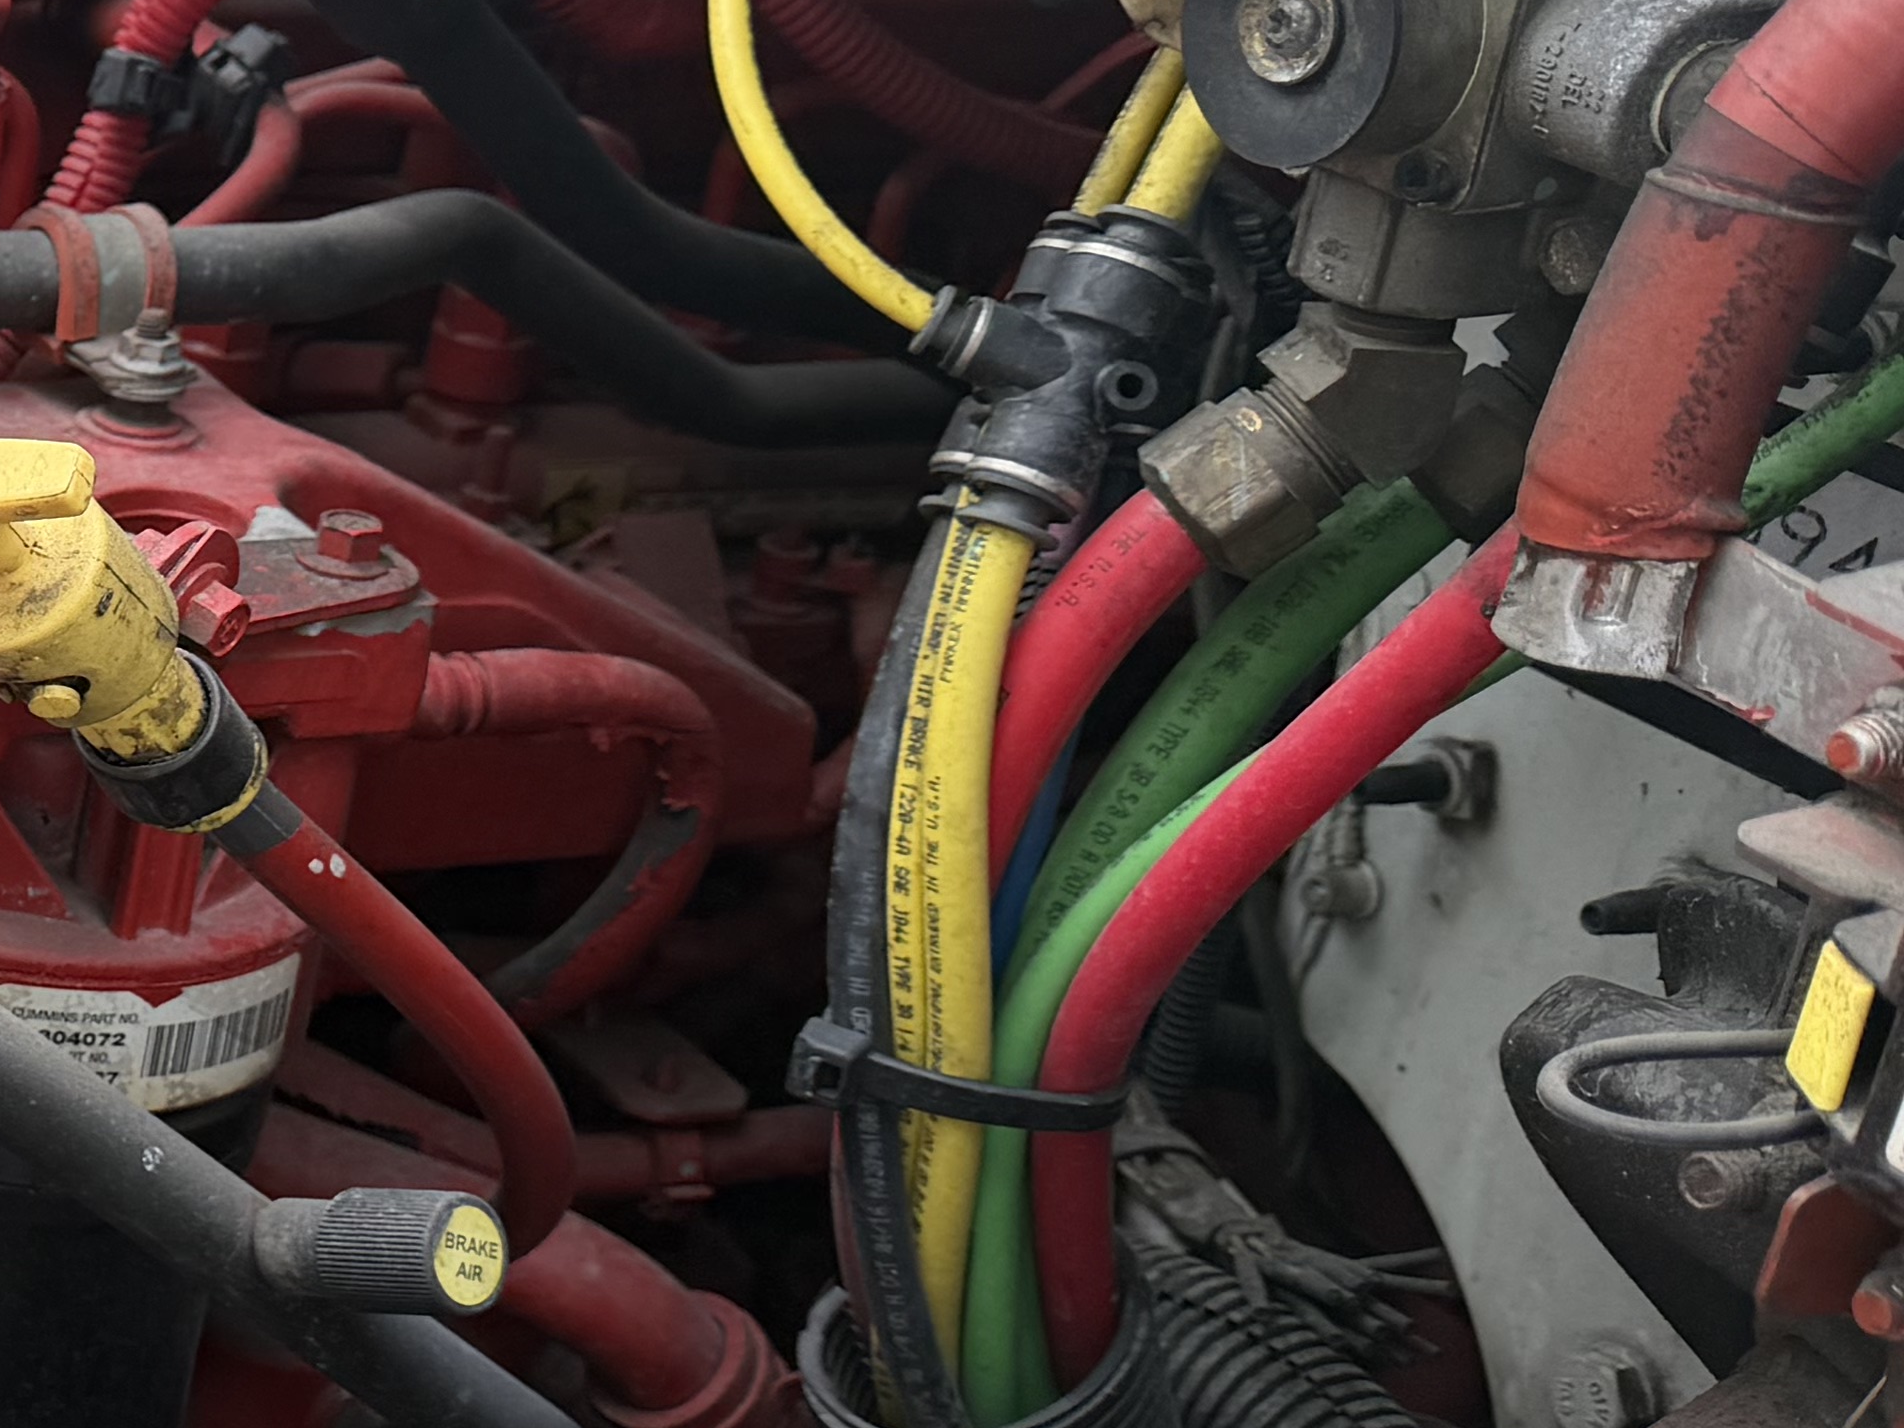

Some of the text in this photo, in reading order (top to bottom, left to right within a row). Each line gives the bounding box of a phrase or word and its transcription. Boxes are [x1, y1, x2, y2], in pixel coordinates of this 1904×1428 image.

[913, 672, 936, 708] AIR
[923, 773, 943, 830] U.S.A.
[925, 839, 939, 866] THE
[12, 1007, 78, 1023] CUMMINS
[82, 1012, 116, 1023] PART
[445, 1231, 498, 1260] BRAKE
[456, 1262, 483, 1282] AIR
